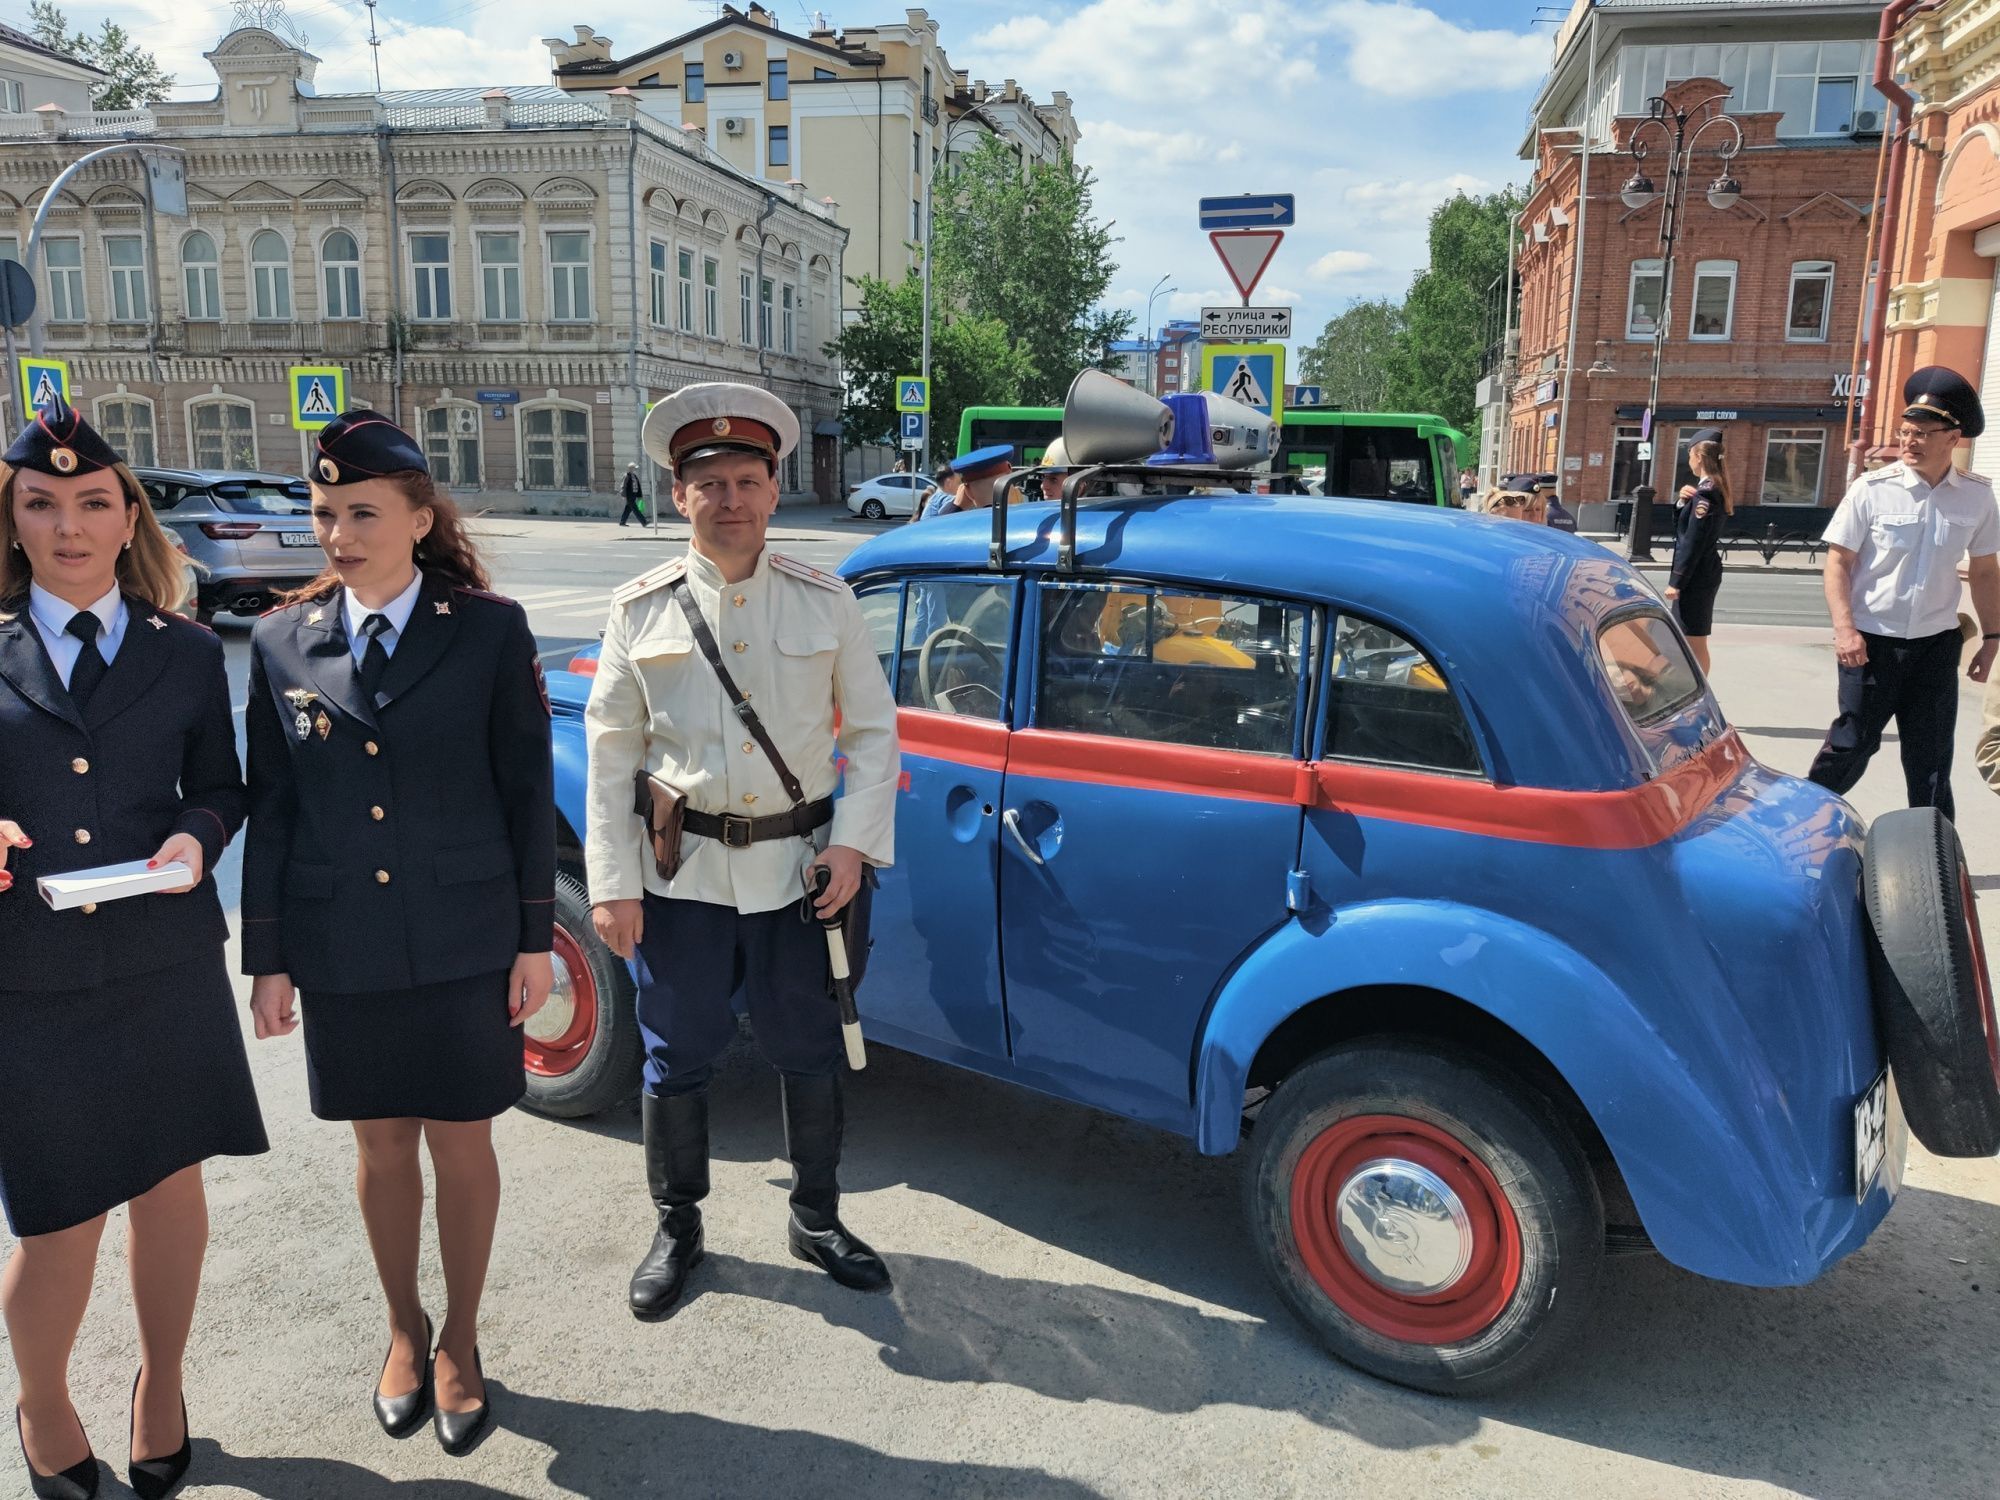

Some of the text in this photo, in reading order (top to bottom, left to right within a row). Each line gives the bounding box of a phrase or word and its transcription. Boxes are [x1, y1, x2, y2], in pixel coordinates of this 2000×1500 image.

[1227, 311, 1265, 322] улица
[1203, 324, 1288, 335] РЕСПУБЛИКИ
[906, 415, 919, 436] P
